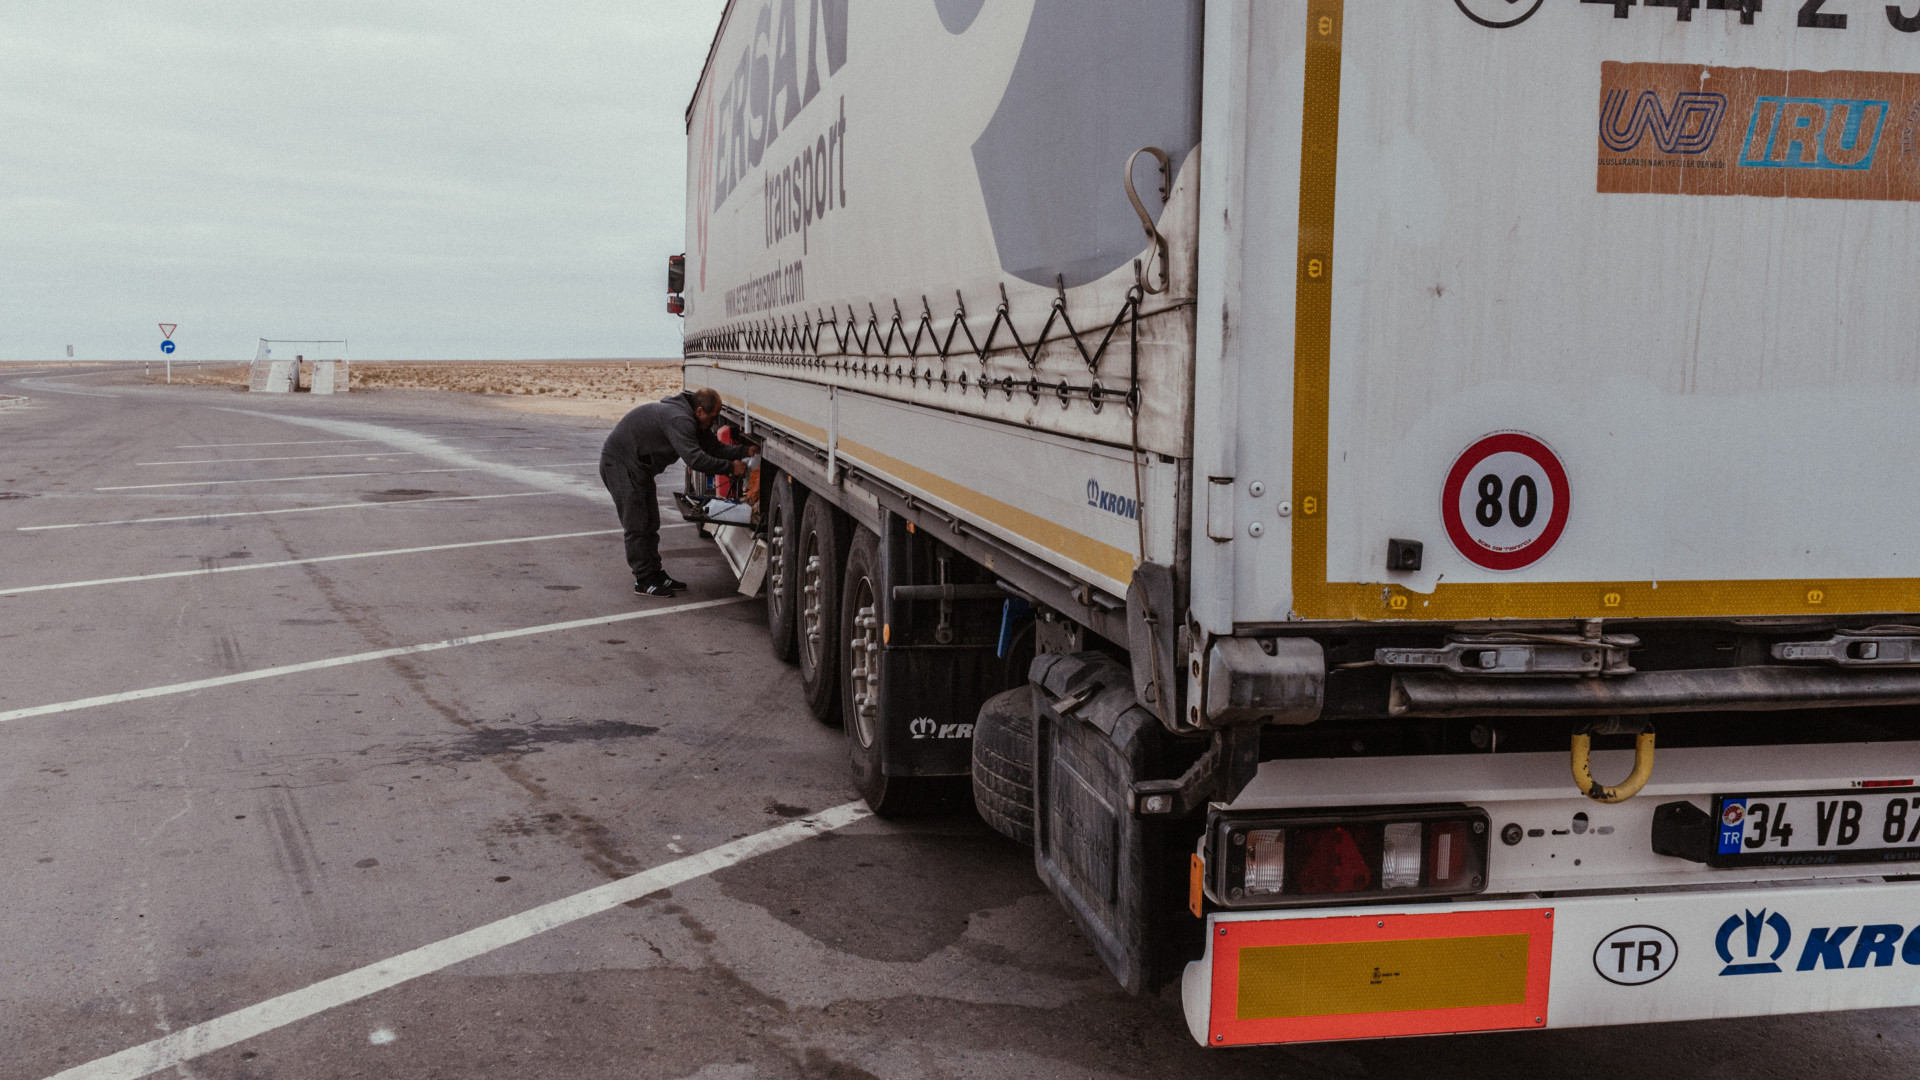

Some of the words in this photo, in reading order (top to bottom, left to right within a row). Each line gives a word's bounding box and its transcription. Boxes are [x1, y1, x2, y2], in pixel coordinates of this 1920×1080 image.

[1599, 89, 1727, 154] UND
[1743, 98, 1886, 167] IRU
[764, 94, 846, 256] transport
[1475, 473, 1538, 528] 80
[1723, 832, 1740, 845] TR
[1744, 802, 1793, 848] 34
[1817, 800, 1863, 846] VB
[1610, 940, 1662, 973] TR
